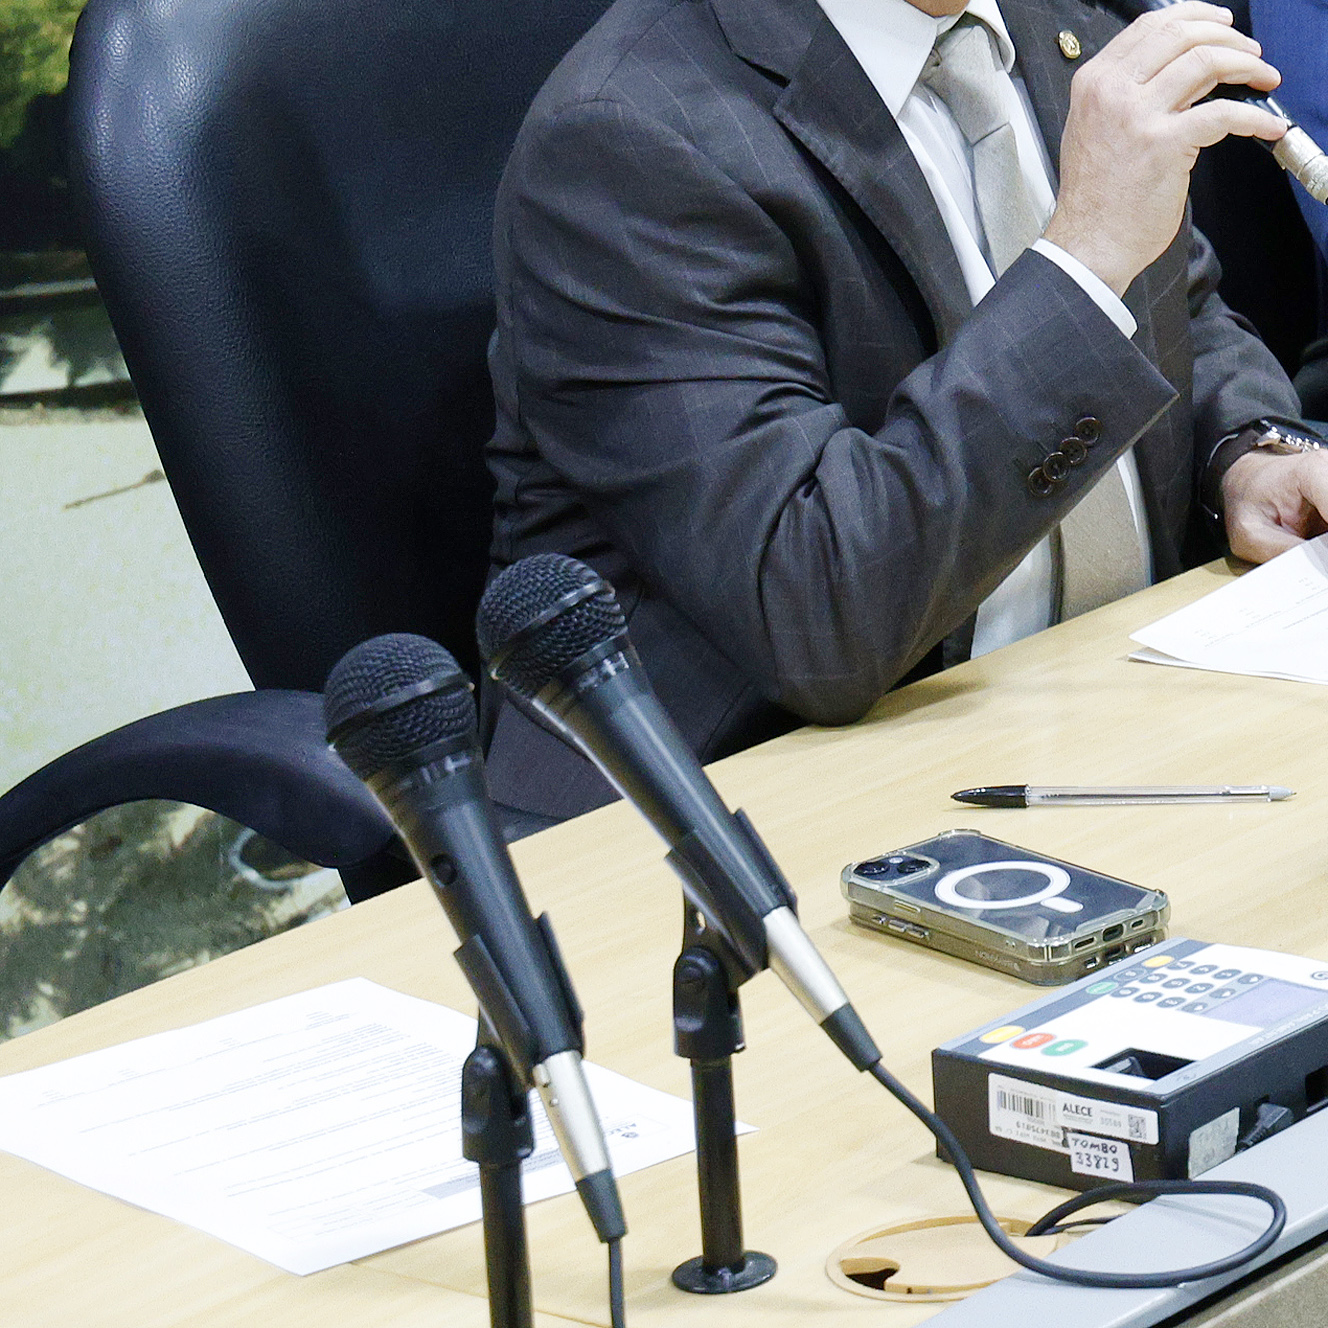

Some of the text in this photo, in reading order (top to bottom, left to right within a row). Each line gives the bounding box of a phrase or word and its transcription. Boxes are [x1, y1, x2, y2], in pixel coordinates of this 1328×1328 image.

[1063, 1103, 1093, 1117] ALECE
[1071, 1138, 1117, 1154] TOMBO
[1076, 1152, 1120, 1172] 33829
